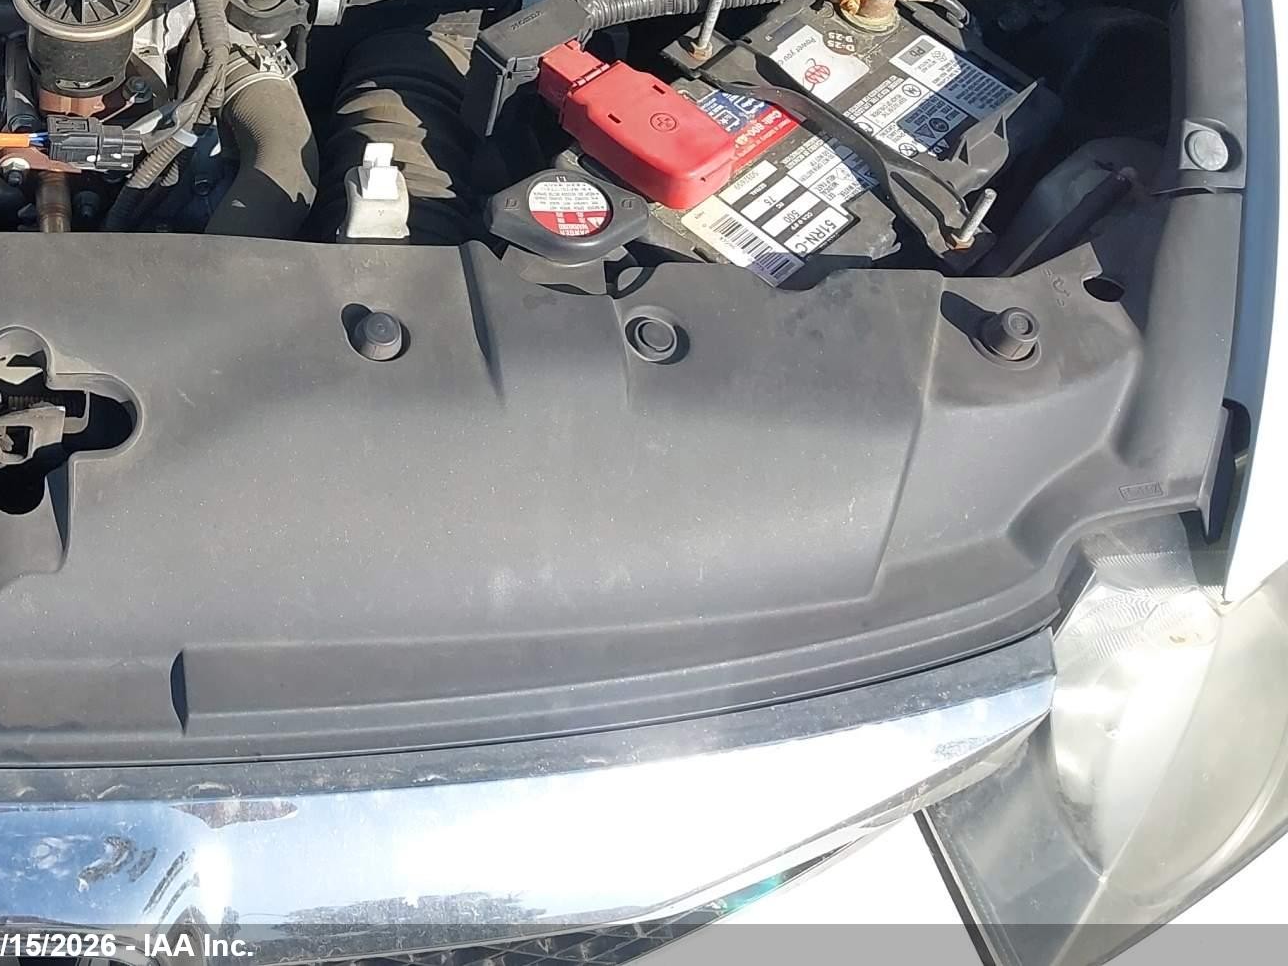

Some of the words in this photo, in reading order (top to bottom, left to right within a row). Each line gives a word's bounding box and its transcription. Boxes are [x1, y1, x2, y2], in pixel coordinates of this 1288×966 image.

[794, 36, 816, 53] Power
[908, 45, 925, 58] Pb
[781, 50, 798, 62] you
[762, 195, 777, 206] 75
[781, 209, 801, 224] 500
[792, 218, 837, 254] 51RN-C
